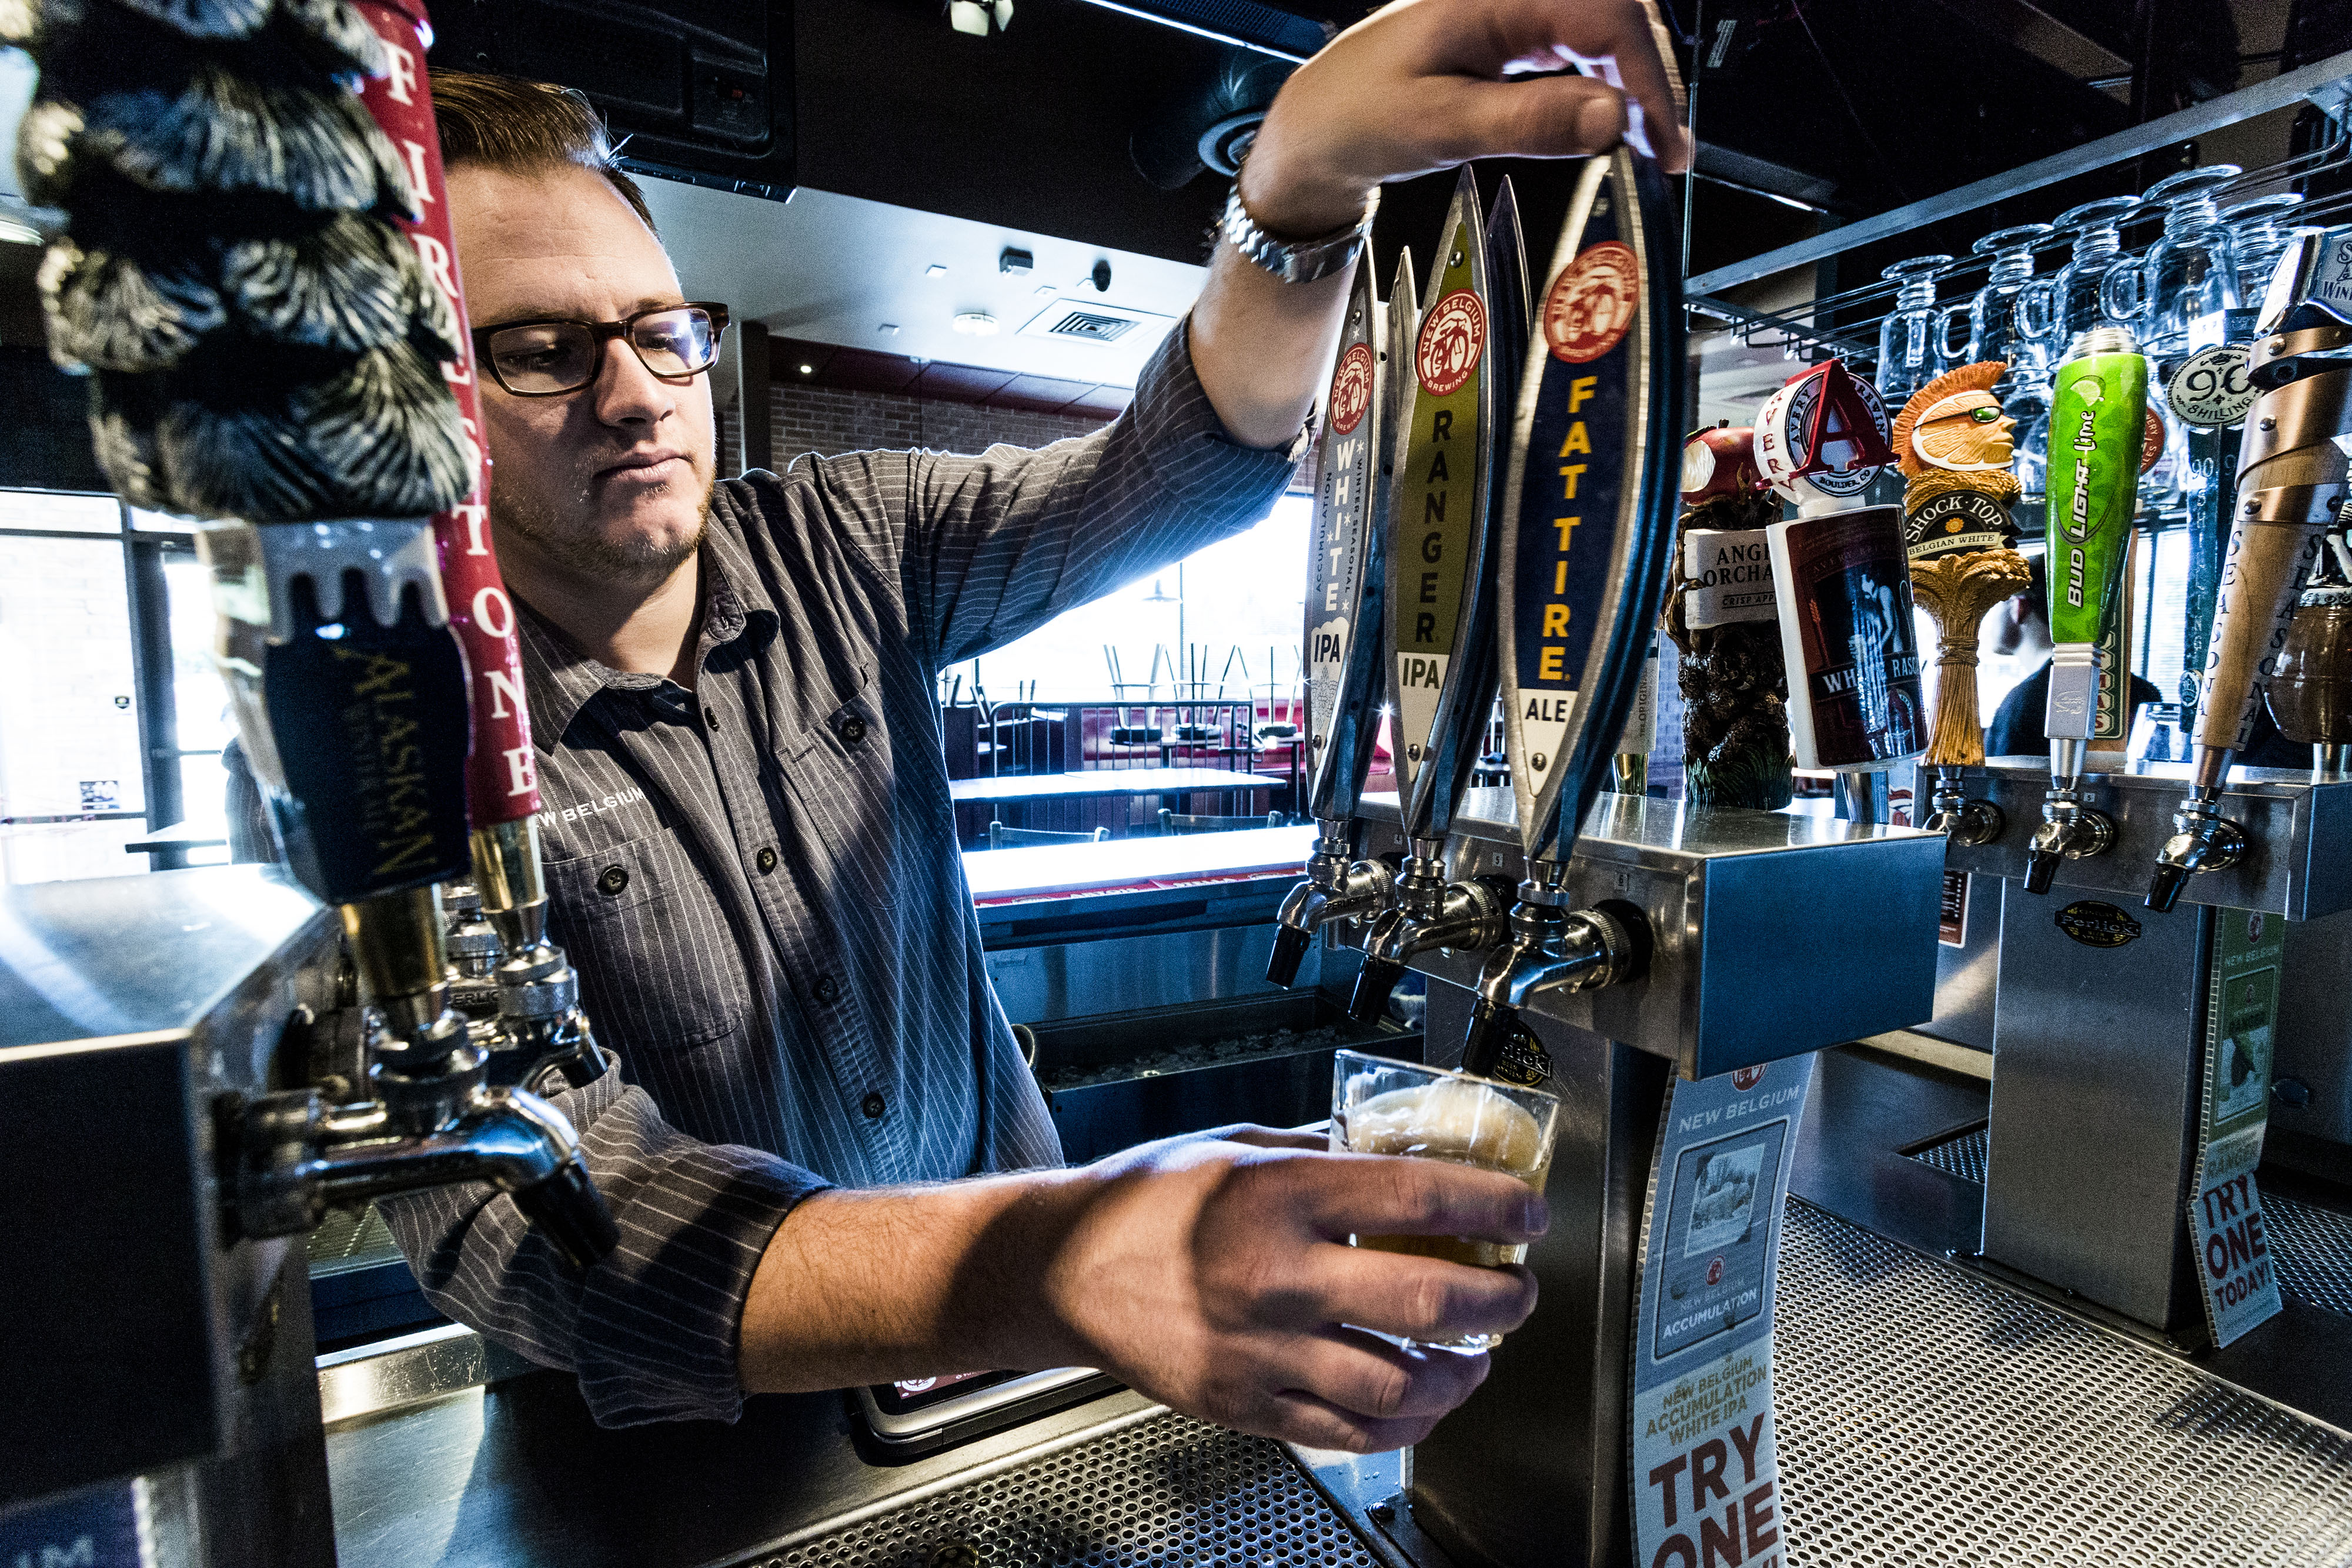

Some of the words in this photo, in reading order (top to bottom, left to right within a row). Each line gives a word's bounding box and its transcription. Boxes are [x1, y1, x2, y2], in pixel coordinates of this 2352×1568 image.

[1422, 315, 1440, 352] NEW
[1443, 298, 1481, 337] BELGIUM
[1334, 366, 1345, 398] NEW
[1347, 351, 1369, 383] BELGIUM
[1427, 370, 1468, 392] BREWING
[2186, 363, 2252, 403] 90
[1336, 412, 1361, 431] BREWING
[1790, 389, 1811, 443] AVERY
[2187, 397, 2253, 420] SHILLING
[1559, 375, 1598, 500] FAT
[1354, 458, 1362, 513] WINTER
[1860, 470, 1870, 480] CO
[2191, 457, 2214, 480] 90
[1325, 438, 1356, 611] WHITE
[1905, 496, 1964, 542] SHOCK
[2070, 458, 2090, 539] LIGHT
[1316, 472, 1332, 593] ACCUMULATION
[1415, 410, 1454, 643] RANGER
[1908, 538, 1955, 556] BELGIAN
[1959, 534, 1995, 545] WHITE
[1344, 519, 1358, 593] SEASONAL
[2067, 547, 2085, 609] BUD
[1538, 516, 1582, 681] TIRE
[1722, 596, 1752, 606] CRISP
[1756, 594, 1776, 602] APP
[1314, 633, 1341, 664] IPA
[2234, 534, 2322, 744] SEASONAL
[1402, 658, 1441, 690] IPA
[1525, 697, 1568, 723] ALE
[333, 647, 439, 876] ALASKAN
[563, 786, 647, 823] BELGIUM
[1496, 1065, 1523, 1080] SYSTEM
[1502, 1059, 1518, 1071] BEER
[1678, 1107, 1722, 1134] NEW
[1726, 1085, 1800, 1121] BELGIUM
[2203, 1175, 2250, 1229] TRY
[2207, 1211, 2267, 1281] ONE
[1662, 1286, 1758, 1340] ACCUMULATION
[2214, 1261, 2273, 1312] TODAY!
[1646, 1363, 1768, 1439] ACCUMULATION
[1663, 1382, 1695, 1410] NEW
[1698, 1355, 1753, 1394] BELGIUM
[1668, 1409, 1721, 1446] WHITE
[1723, 1394, 1748, 1421] IPA
[1648, 1411, 1766, 1529] TRY
[1650, 1480, 1779, 1568] ONE
